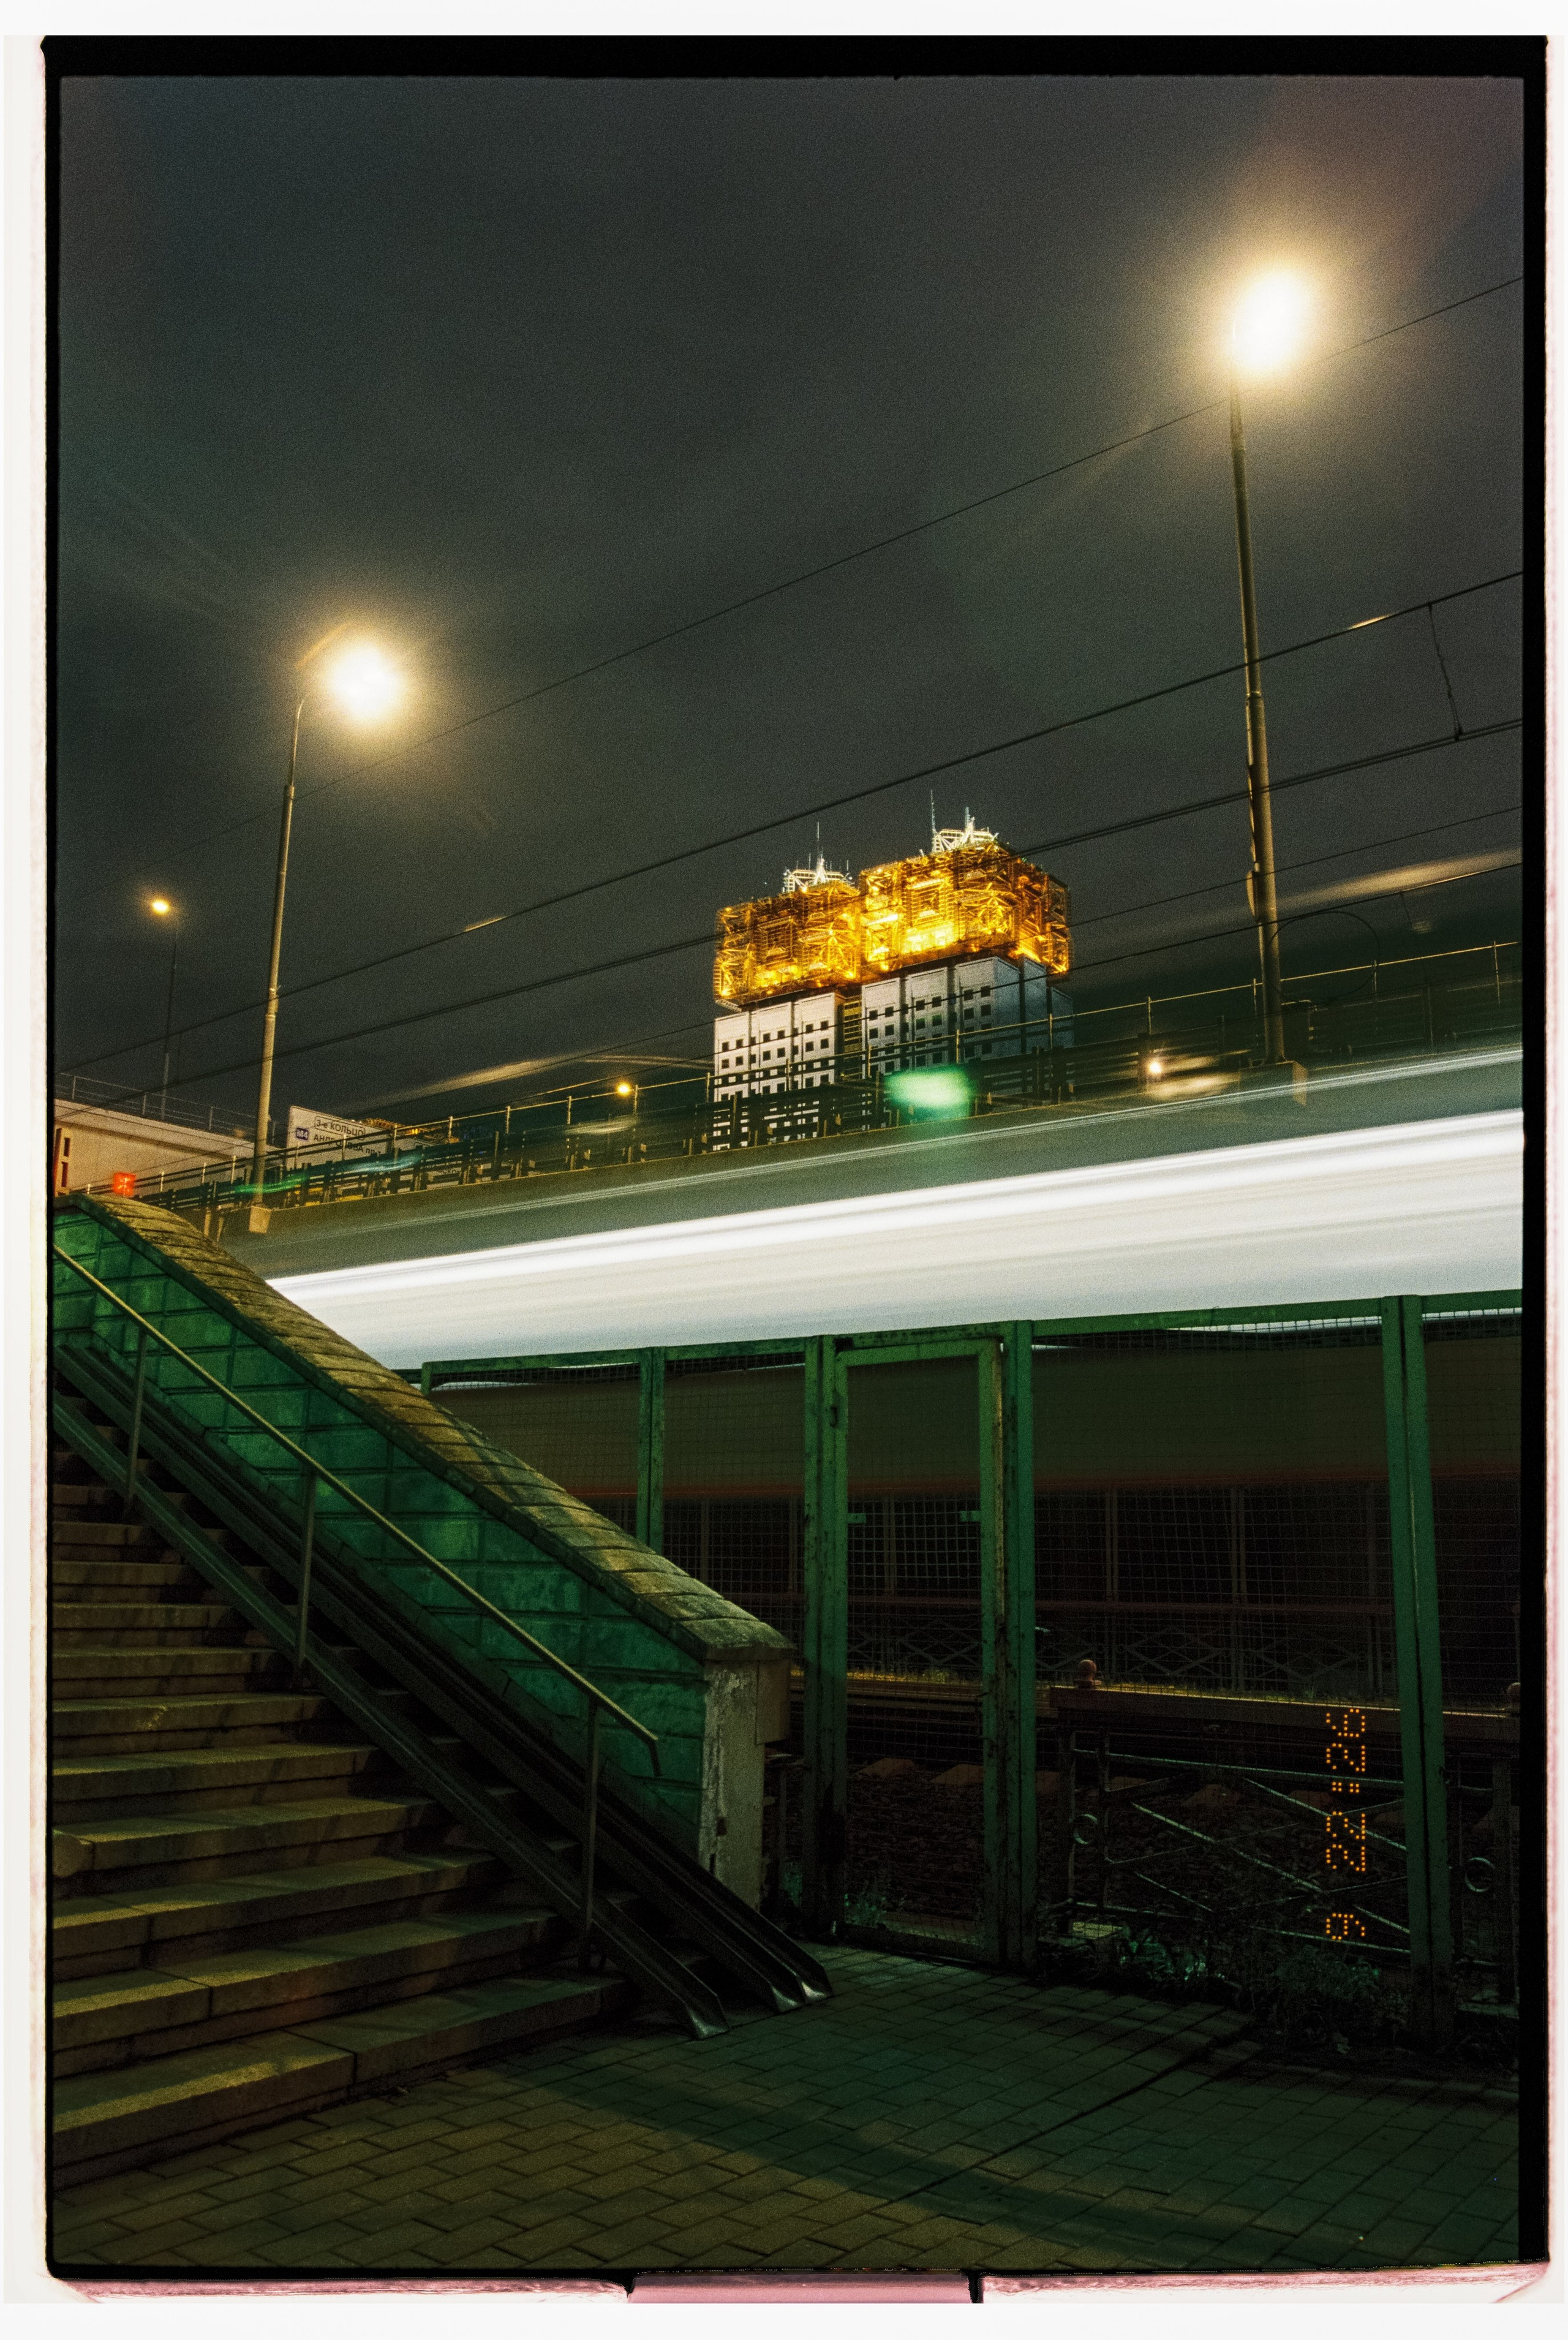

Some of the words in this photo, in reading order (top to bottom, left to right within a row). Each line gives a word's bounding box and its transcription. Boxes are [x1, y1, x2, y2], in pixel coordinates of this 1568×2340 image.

[316, 1119, 328, 1128] 3-е
[330, 1121, 363, 1136] КОЛЬЦО
[314, 1134, 364, 1152] АНДООВА
